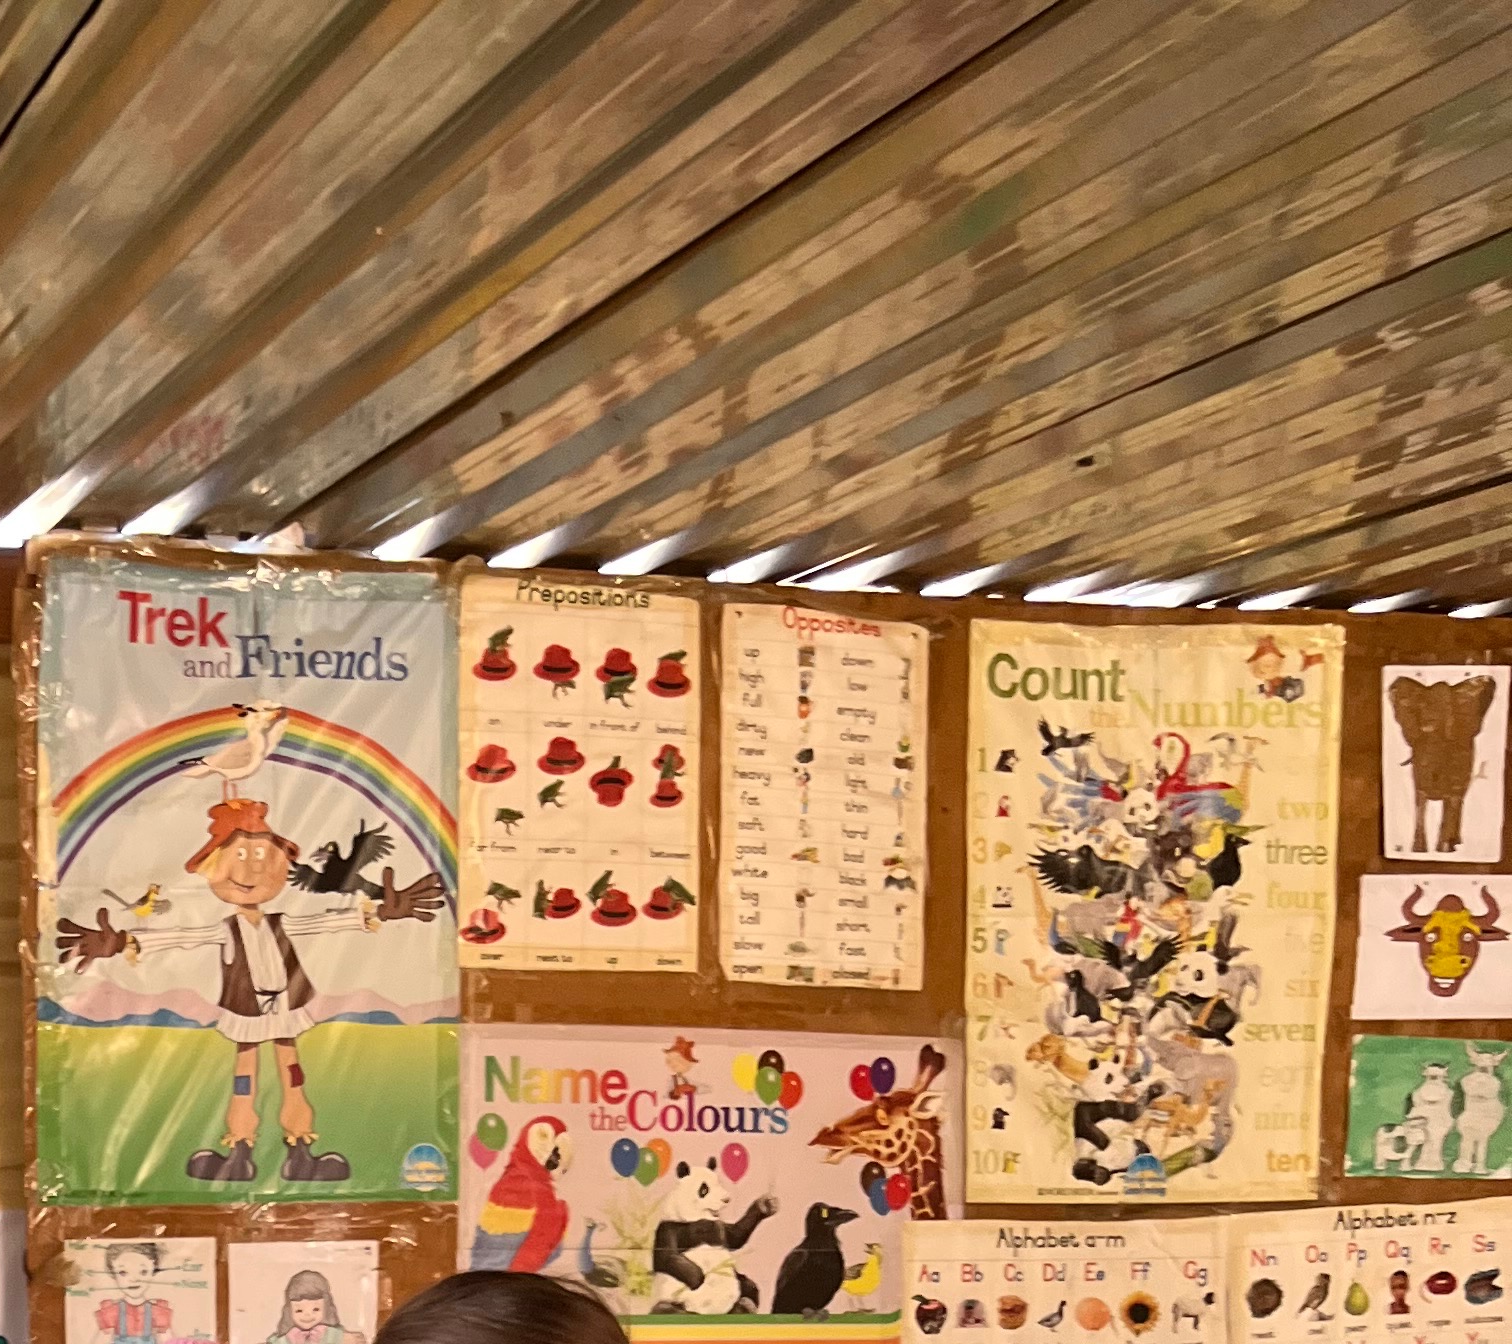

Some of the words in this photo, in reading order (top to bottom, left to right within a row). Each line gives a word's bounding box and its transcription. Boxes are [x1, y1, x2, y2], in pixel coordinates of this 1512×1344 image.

[516, 580, 650, 611] Prepositions
[118, 590, 230, 648] Trek
[783, 606, 881, 641] Opposites
[183, 652, 233, 679] and
[234, 634, 409, 681] Friends
[987, 652, 1126, 702] Count
[1125, 687, 1325, 730] Numbers
[976, 746, 988, 773] 1
[972, 837, 987, 865] 3
[1265, 838, 1328, 866] three
[1266, 881, 1327, 911] four
[971, 927, 987, 953] 5
[972, 971, 987, 998] 6
[976, 1014, 991, 1041] 7
[1243, 1022, 1317, 1043] seven
[483, 1055, 628, 1104] Name
[590, 1108, 628, 1131] the
[628, 1090, 790, 1135] Colours
[973, 1150, 999, 1175] 10
[1266, 1150, 1313, 1174] ten
[1333, 1208, 1418, 1239] Alphabet
[1422, 1210, 1458, 1226] n-z
[996, 1227, 1080, 1257] Alphabet
[1084, 1234, 1126, 1248] a-m
